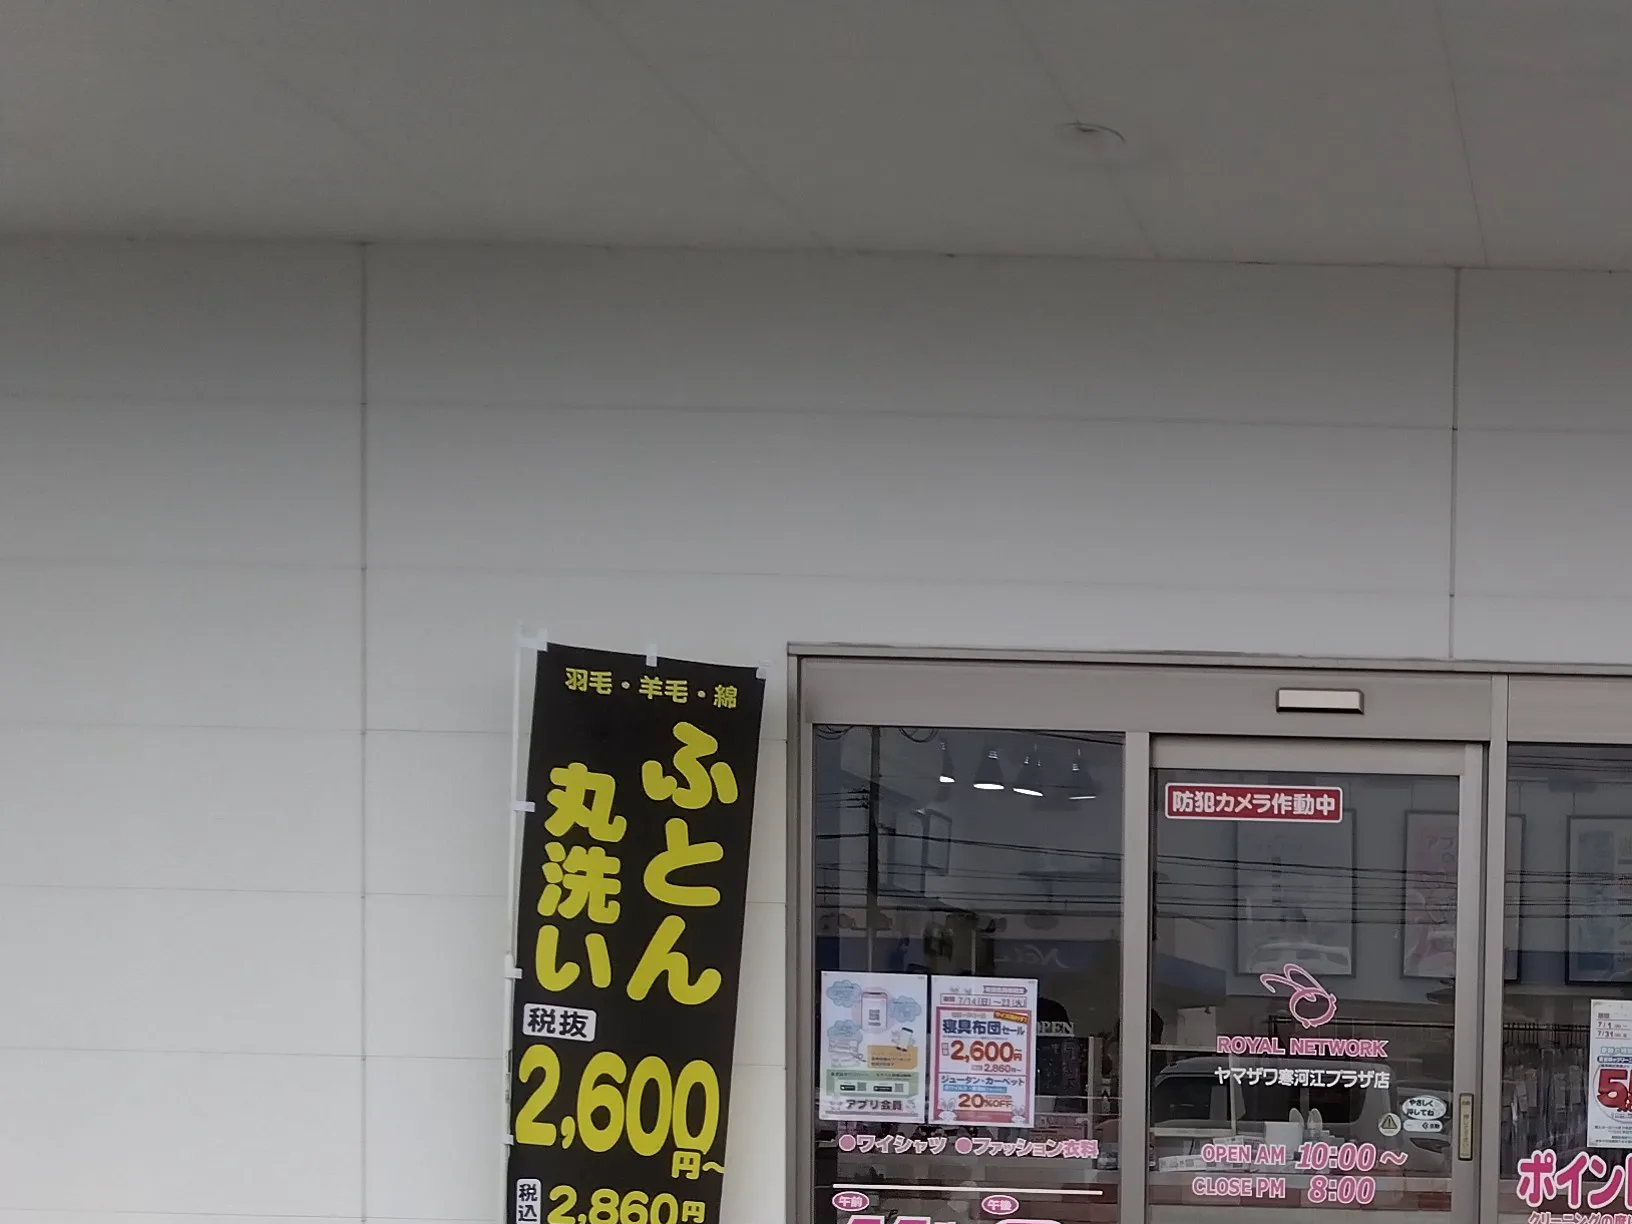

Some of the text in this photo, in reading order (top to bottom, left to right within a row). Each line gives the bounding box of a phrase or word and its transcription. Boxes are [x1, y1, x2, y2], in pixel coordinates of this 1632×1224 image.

[565, 667, 738, 709] 羽毛・羊毛・綿
[1172, 790, 1337, 817] 防犯カメラ作動中
[626, 721, 739, 1006] ふとん
[535, 762, 627, 993] 丸洗い
[526, 1006, 591, 1039] 税抜
[1036, 1020, 1075, 1037] PEN
[1216, 1035, 1389, 1058] ROYAL NETWORK
[1214, 1066, 1391, 1089] ヤマザワ寒河江プラザ店
[856, 1135, 947, 1155] ワイシャツ
[971, 1137, 1100, 1159] ファッション衣料
[1201, 1143, 1251, 1163] OPEN
[1253, 1144, 1286, 1166] AM
[1191, 1175, 1376, 1205] CLOSE PM 8:00
[517, 1182, 540, 1224] 税込
[837, 1196, 864, 1208] 午前
[987, 1199, 1013, 1211] 午後
